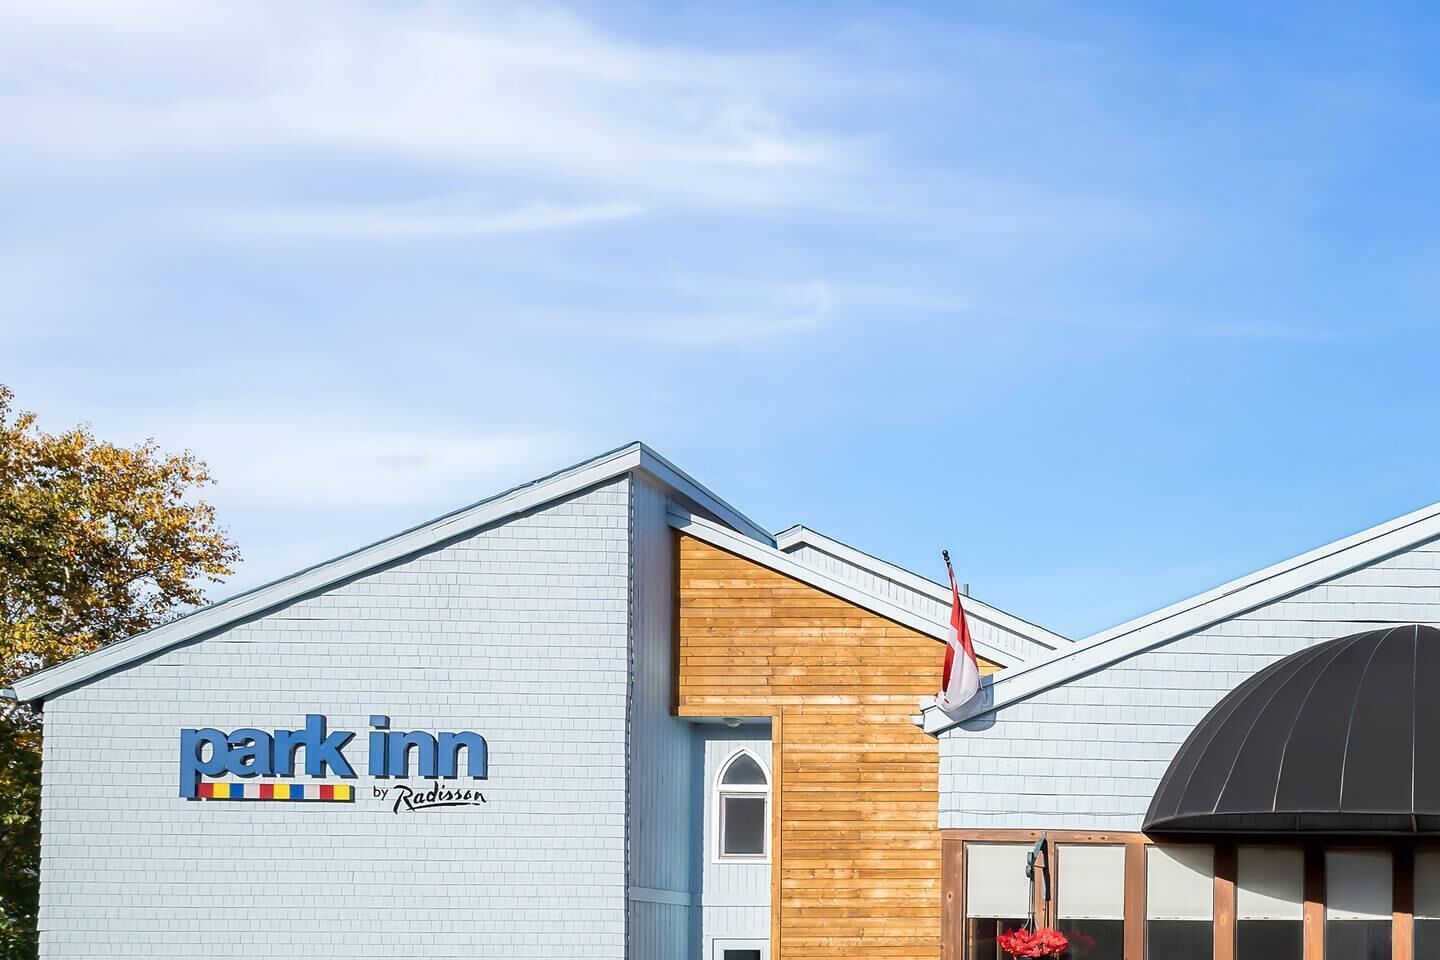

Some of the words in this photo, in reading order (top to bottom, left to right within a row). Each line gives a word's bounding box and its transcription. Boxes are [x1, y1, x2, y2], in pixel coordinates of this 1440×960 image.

[179, 714, 358, 799] park
[368, 714, 489, 780] inn
[373, 785, 389, 800] by
[393, 781, 487, 814] Radisson
